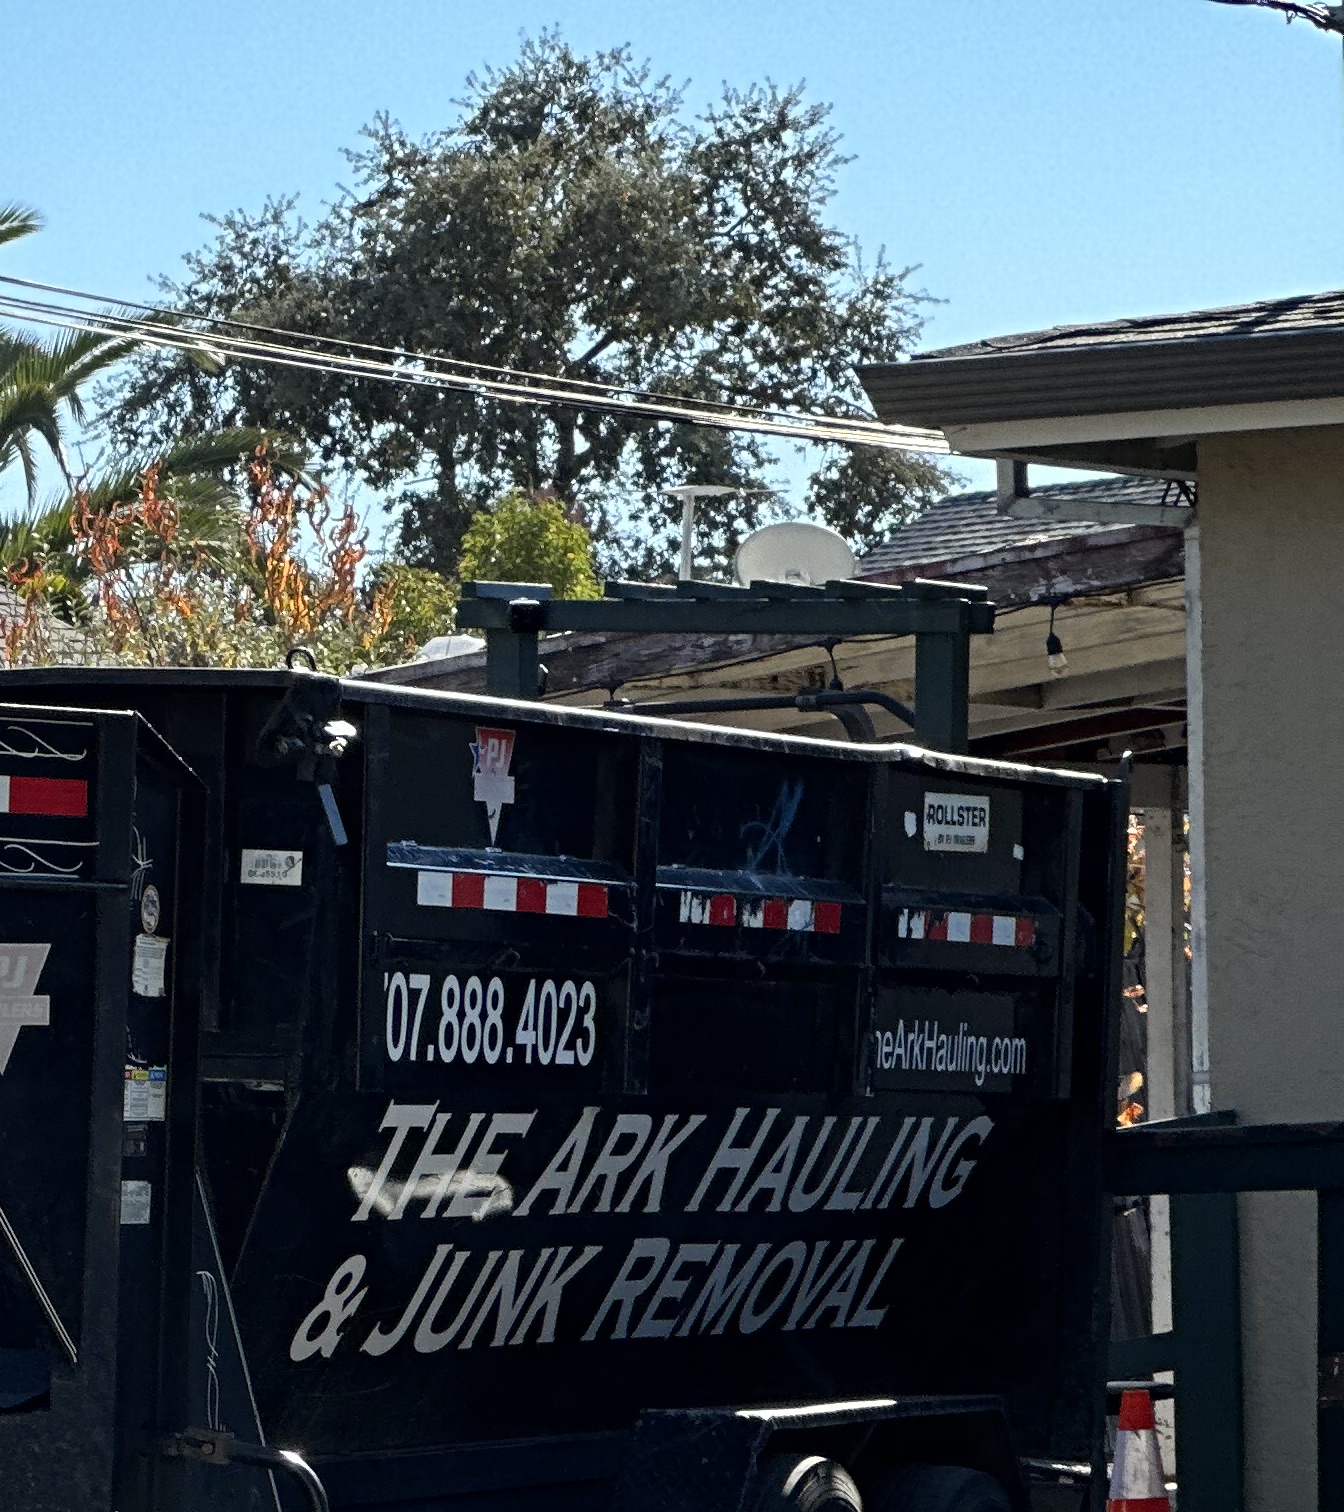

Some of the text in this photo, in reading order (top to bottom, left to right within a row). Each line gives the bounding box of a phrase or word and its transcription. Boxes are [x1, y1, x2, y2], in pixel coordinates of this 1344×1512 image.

[485, 737, 507, 769] PJ
[926, 804, 987, 827] ROLLSTER
[384, 971, 597, 1066] 07.888.4023
[350, 1099, 996, 1222] THE ARK HAULING
[290, 1237, 906, 1362] & JUNK REMOVAL
